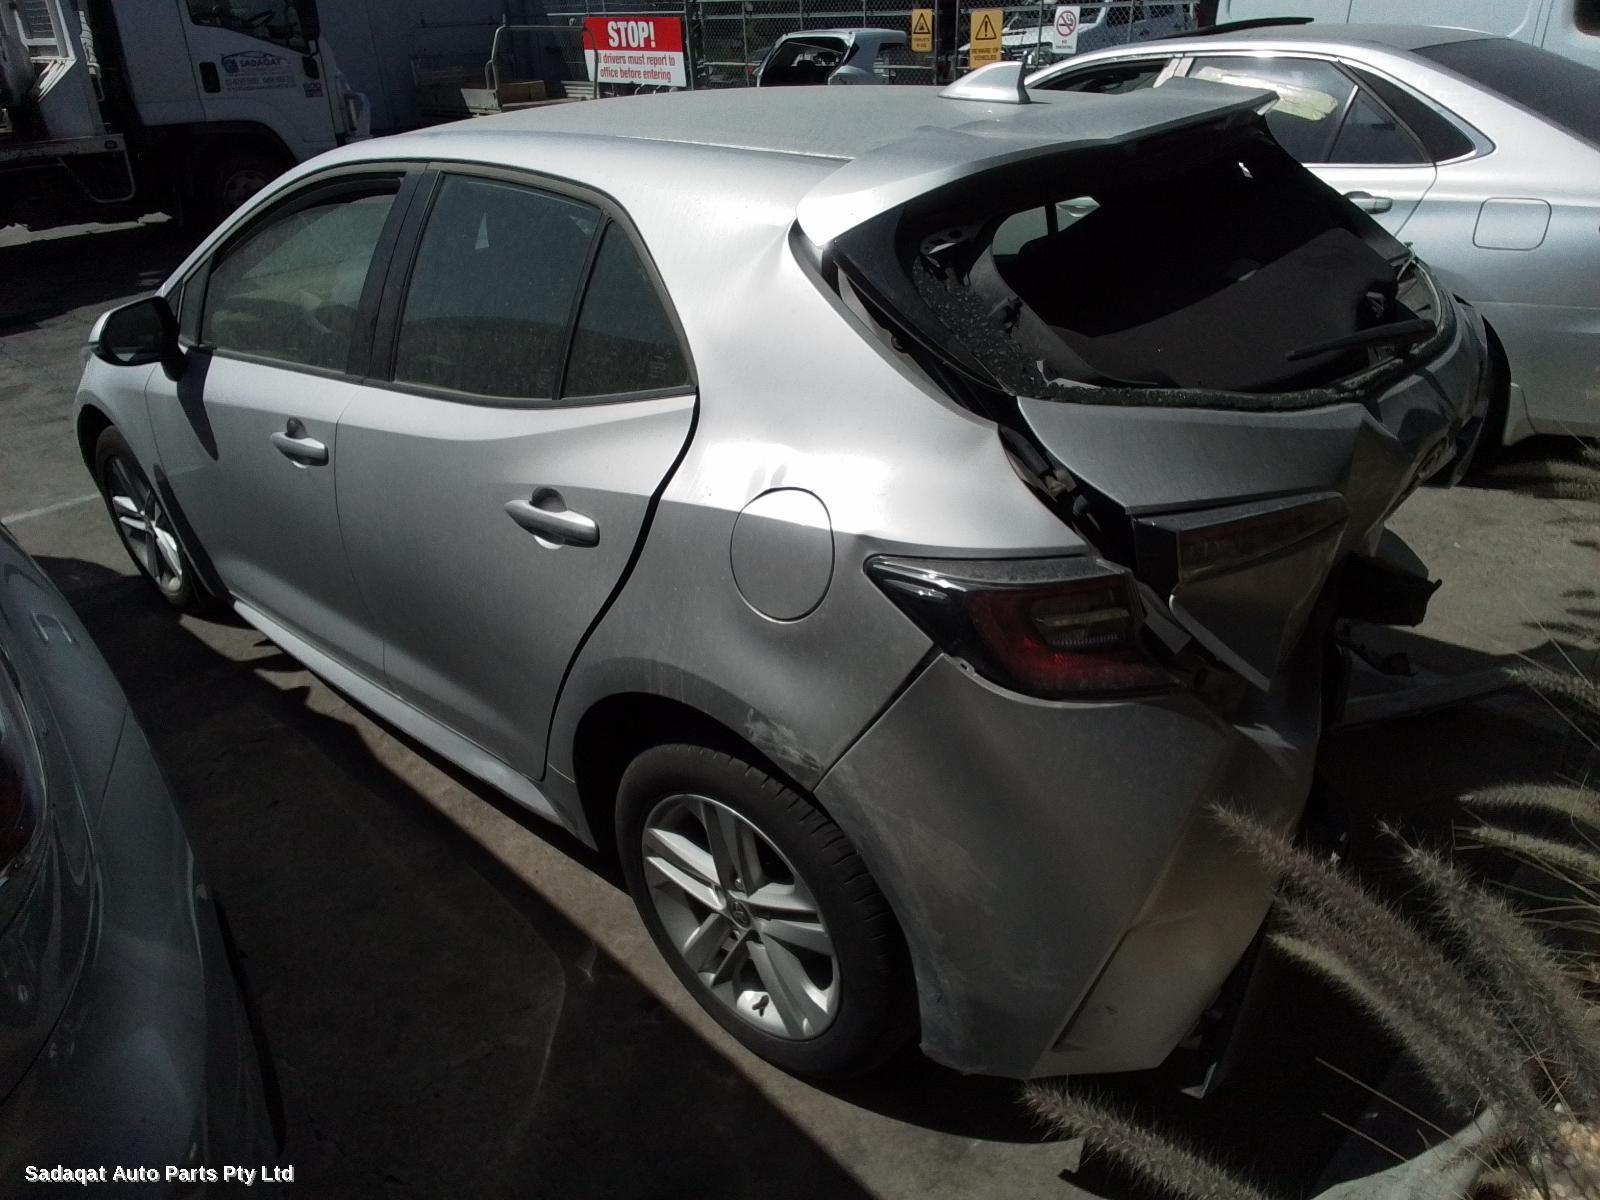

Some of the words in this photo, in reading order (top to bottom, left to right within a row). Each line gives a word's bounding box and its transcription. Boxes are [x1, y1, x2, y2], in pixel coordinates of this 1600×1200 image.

[607, 20, 656, 48] STOP!
[603, 53, 627, 64] drivers
[628, 53, 646, 65] must
[647, 54, 668, 67] report
[669, 55, 676, 66] to
[600, 66, 619, 78] office
[620, 66, 642, 79] before
[643, 69, 672, 83] entering
